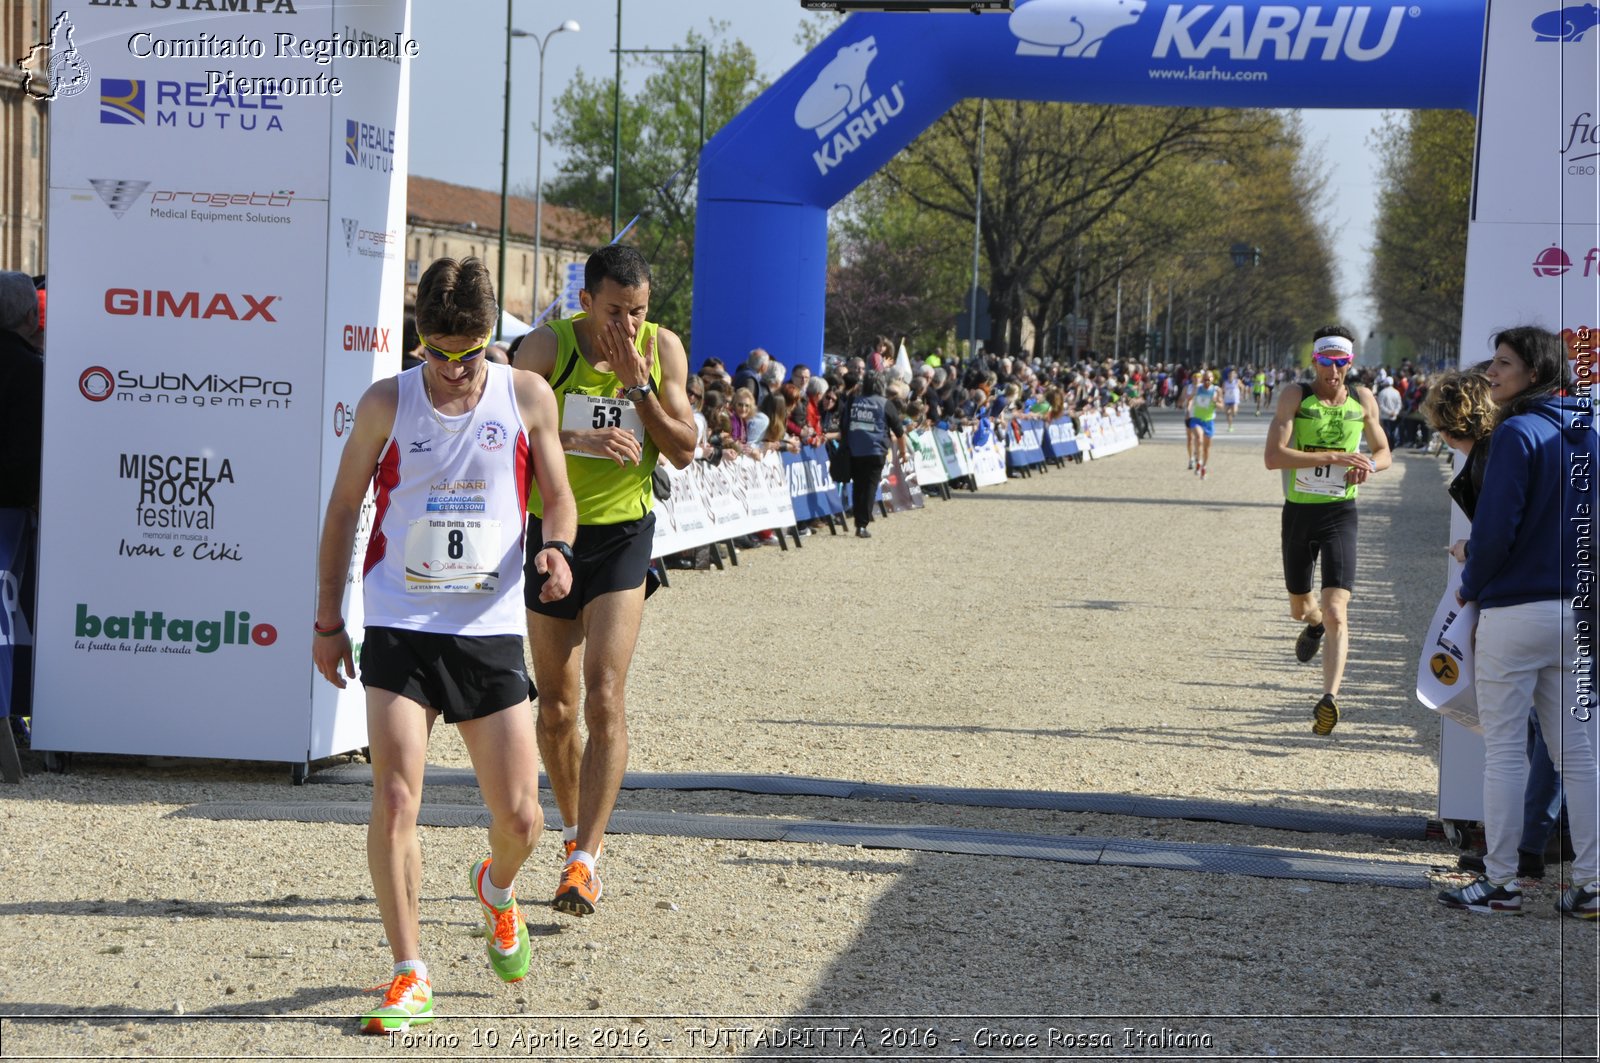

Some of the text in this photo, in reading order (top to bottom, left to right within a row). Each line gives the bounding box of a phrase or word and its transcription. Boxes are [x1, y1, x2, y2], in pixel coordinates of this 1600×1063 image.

[1151, 4, 1406, 62] KARHU
[1148, 66, 1268, 81] www.karhu.com
[157, 80, 283, 110] REALE
[157, 111, 283, 132] MUTUA
[812, 83, 905, 176] KARHU
[361, 123, 395, 154] REALE
[361, 152, 394, 175] MUTUA
[1568, 165, 1596, 176] CIBO
[151, 189, 295, 208] progetti
[150, 208, 292, 224] Medical Equipment Solutions
[104, 288, 278, 323] GIMAX
[343, 324, 390, 353] GIMAX
[118, 370, 292, 396] SubMixPro
[117, 392, 292, 409] management
[592, 405, 622, 430] 53
[119, 453, 235, 484] MISCELA
[1314, 464, 1331, 479] 61
[141, 479, 215, 507] ROCK
[136, 503, 215, 530] festival
[439, 503, 485, 511] GERVASONI
[142, 531, 172, 540] memorial
[180, 533, 203, 542] musica
[429, 520, 446, 528] Tutta
[467, 521, 481, 529] 2016
[119, 538, 243, 561] Ivan e Ciki
[447, 529, 464, 560] 8
[75, 603, 278, 653] battaglio
[74, 640, 192, 655] la frutta ha fatto strada
